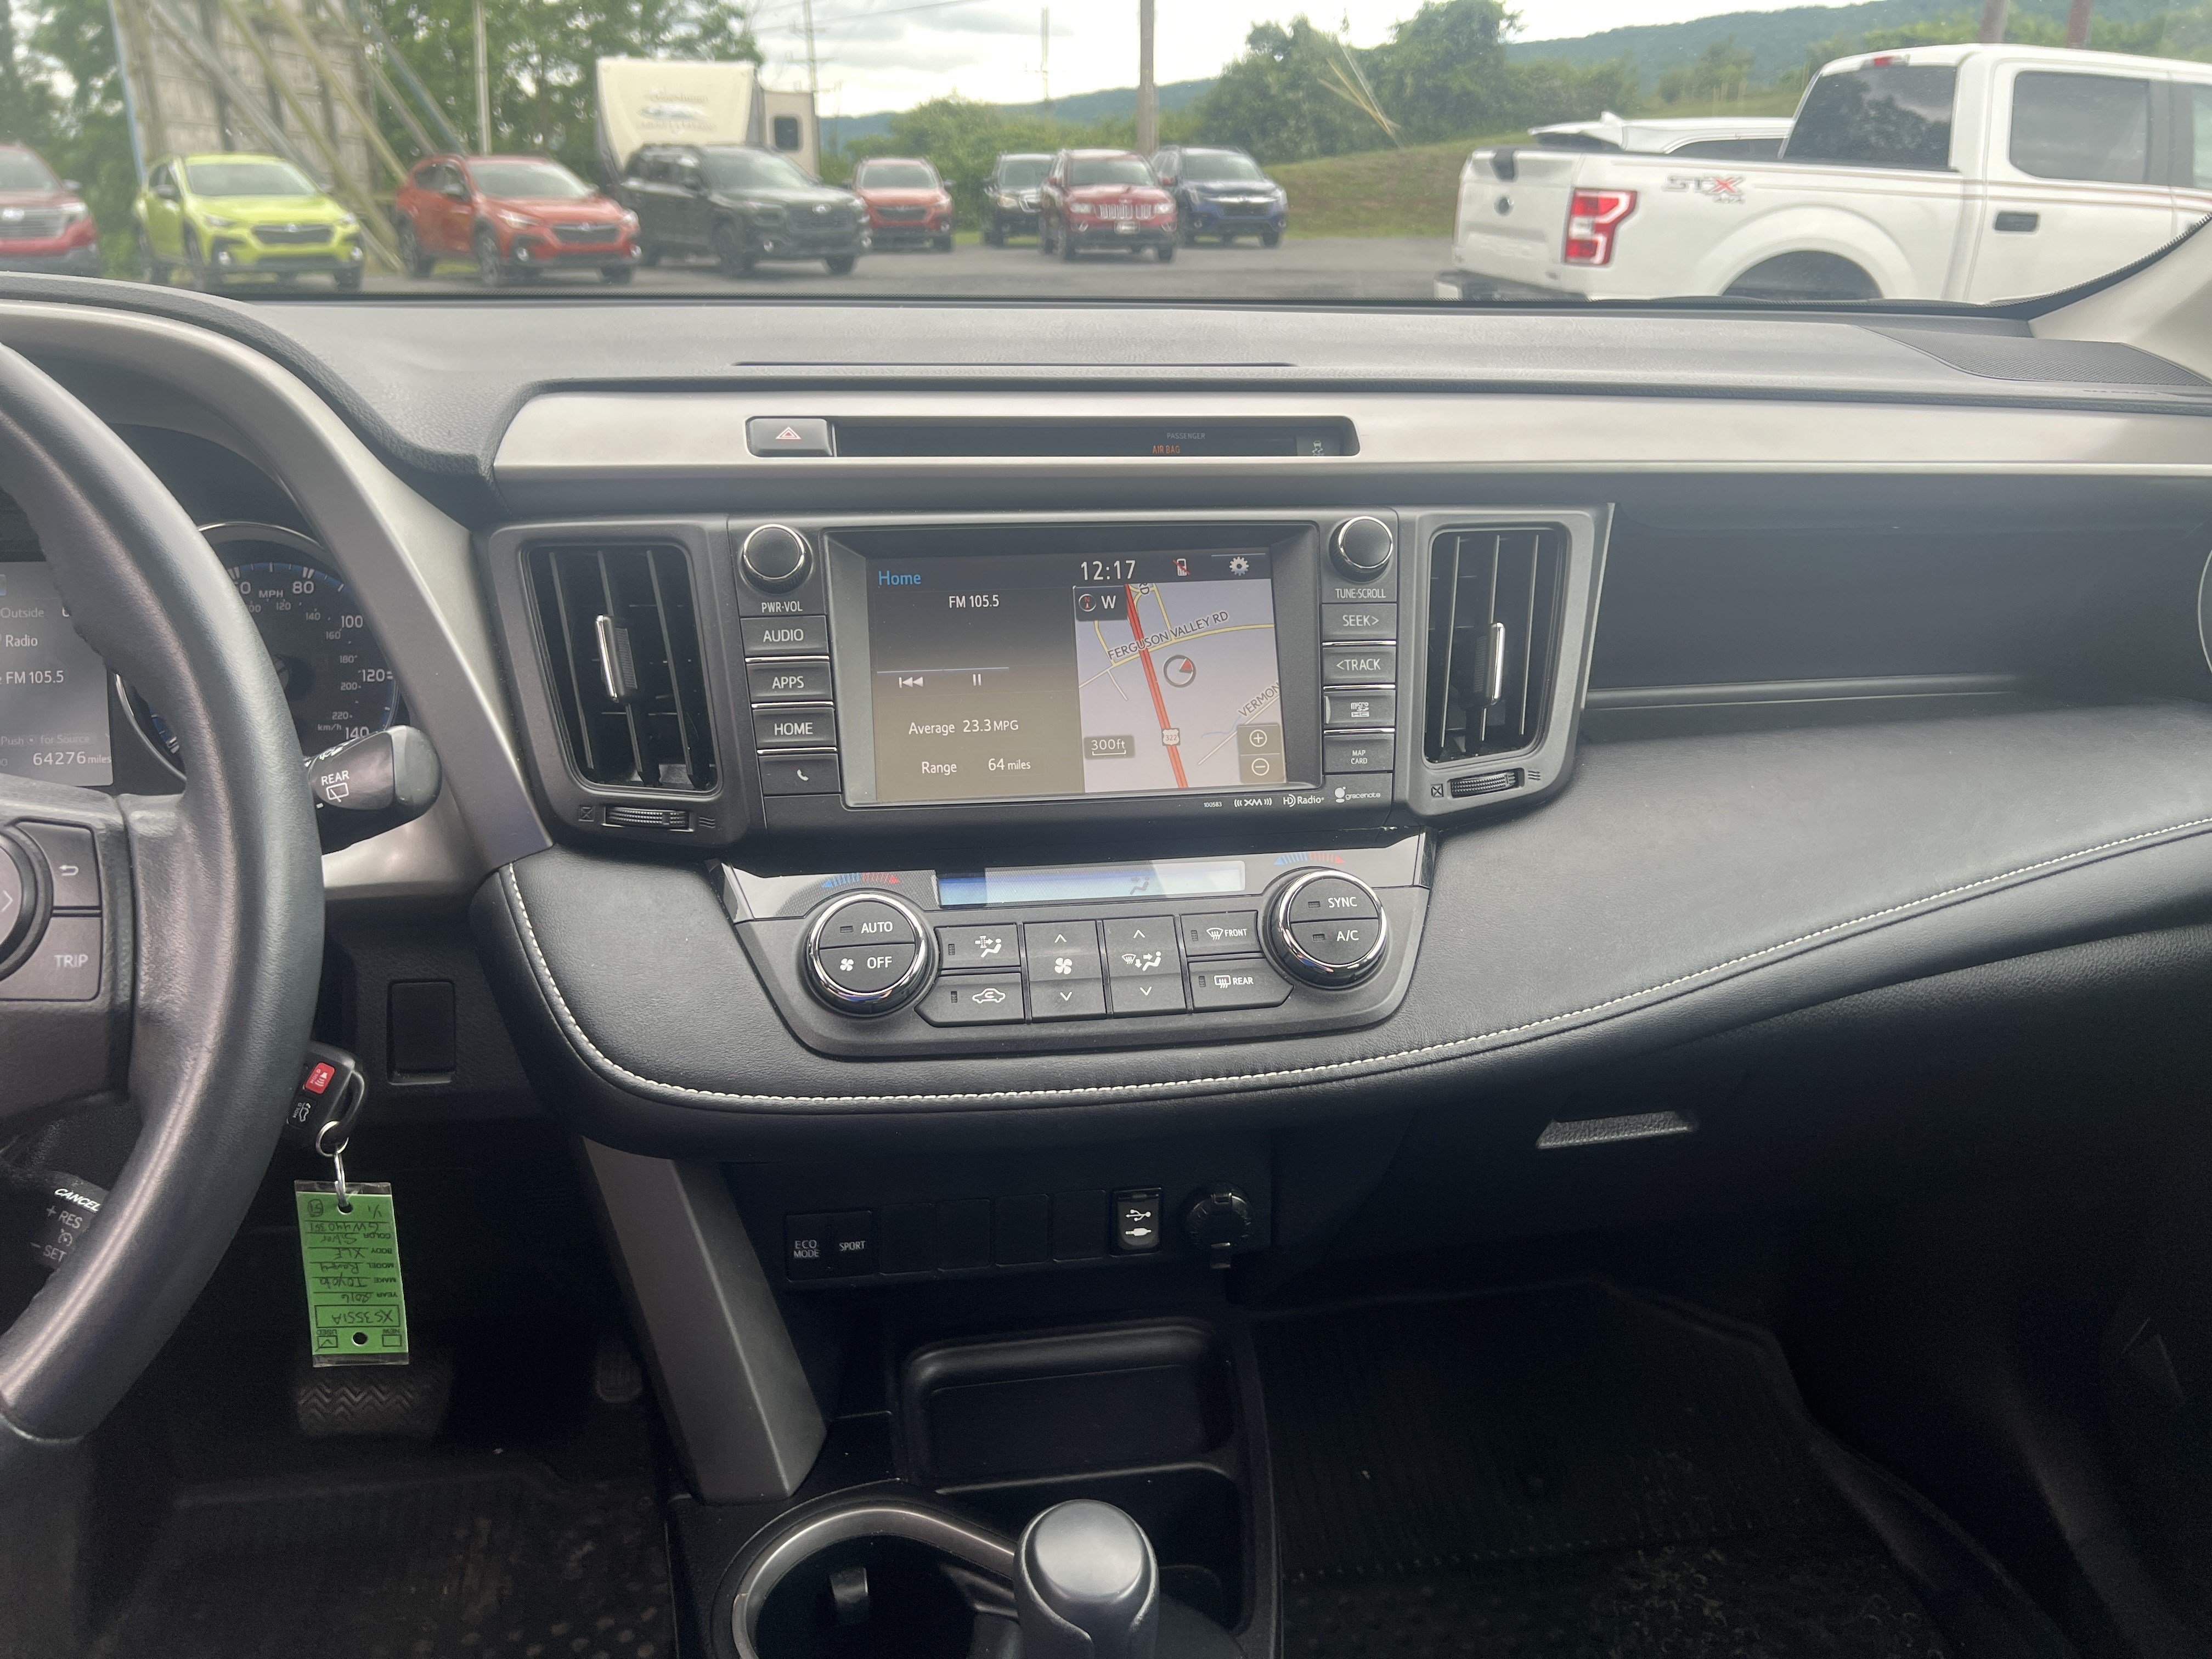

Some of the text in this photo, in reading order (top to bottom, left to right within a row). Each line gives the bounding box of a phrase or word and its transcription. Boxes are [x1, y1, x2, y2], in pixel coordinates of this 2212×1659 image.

[1152, 445, 1180, 454] AIR BAG
[1080, 560, 1136, 581] 12:17
[878, 570, 922, 586] Home
[259, 589, 284, 598] MPH
[292, 580, 314, 594] 80
[276, 602, 291, 611] 120
[949, 594, 1000, 608] FM 105.5
[1101, 595, 1116, 609] W
[1, 607, 44, 618] Outside
[306, 612, 321, 620] 140
[341, 615, 363, 628] 100
[5, 634, 38, 647] Radio
[326, 631, 341, 640] 160
[763, 629, 804, 642] AUDIO
[1107, 611, 1229, 660] FERGUSON VALLEY RD
[339, 656, 354, 664] 180
[6, 671, 26, 684] FM
[29, 670, 64, 684] 105.5
[362, 669, 385, 682] 120
[340, 682, 357, 691] 200
[772, 676, 804, 689] APPS
[332, 712, 348, 720] 220
[317, 723, 342, 731] km/h
[774, 722, 813, 736] HOME
[909, 719, 1019, 736] Average 23.3 MPG
[1, 735, 89, 745] Push for Source
[1091, 739, 1126, 752] 300ft
[33, 751, 112, 766] 64276 miles
[922, 758, 1031, 776] Range 64 miles
[321, 770, 349, 786] REAR
[1345, 792, 1381, 800] gracenote
[1328, 896, 1357, 909] SYNC
[861, 921, 893, 933] AUTO
[1224, 928, 1247, 937] FRONT
[1336, 929, 1359, 941] A/C
[54, 954, 88, 968] TRIP
[867, 956, 892, 969] OFF
[1232, 977, 1254, 985] REAR
[54, 1188, 101, 1212] CANCEL
[58, 1210, 83, 1229] RES
[795, 1239, 817, 1249] ECO
[839, 1240, 866, 1251] SPORT
[43, 1244, 67, 1262] SET
[335, 1248, 365, 1260] XLE
[793, 1249, 820, 1258] MODE
